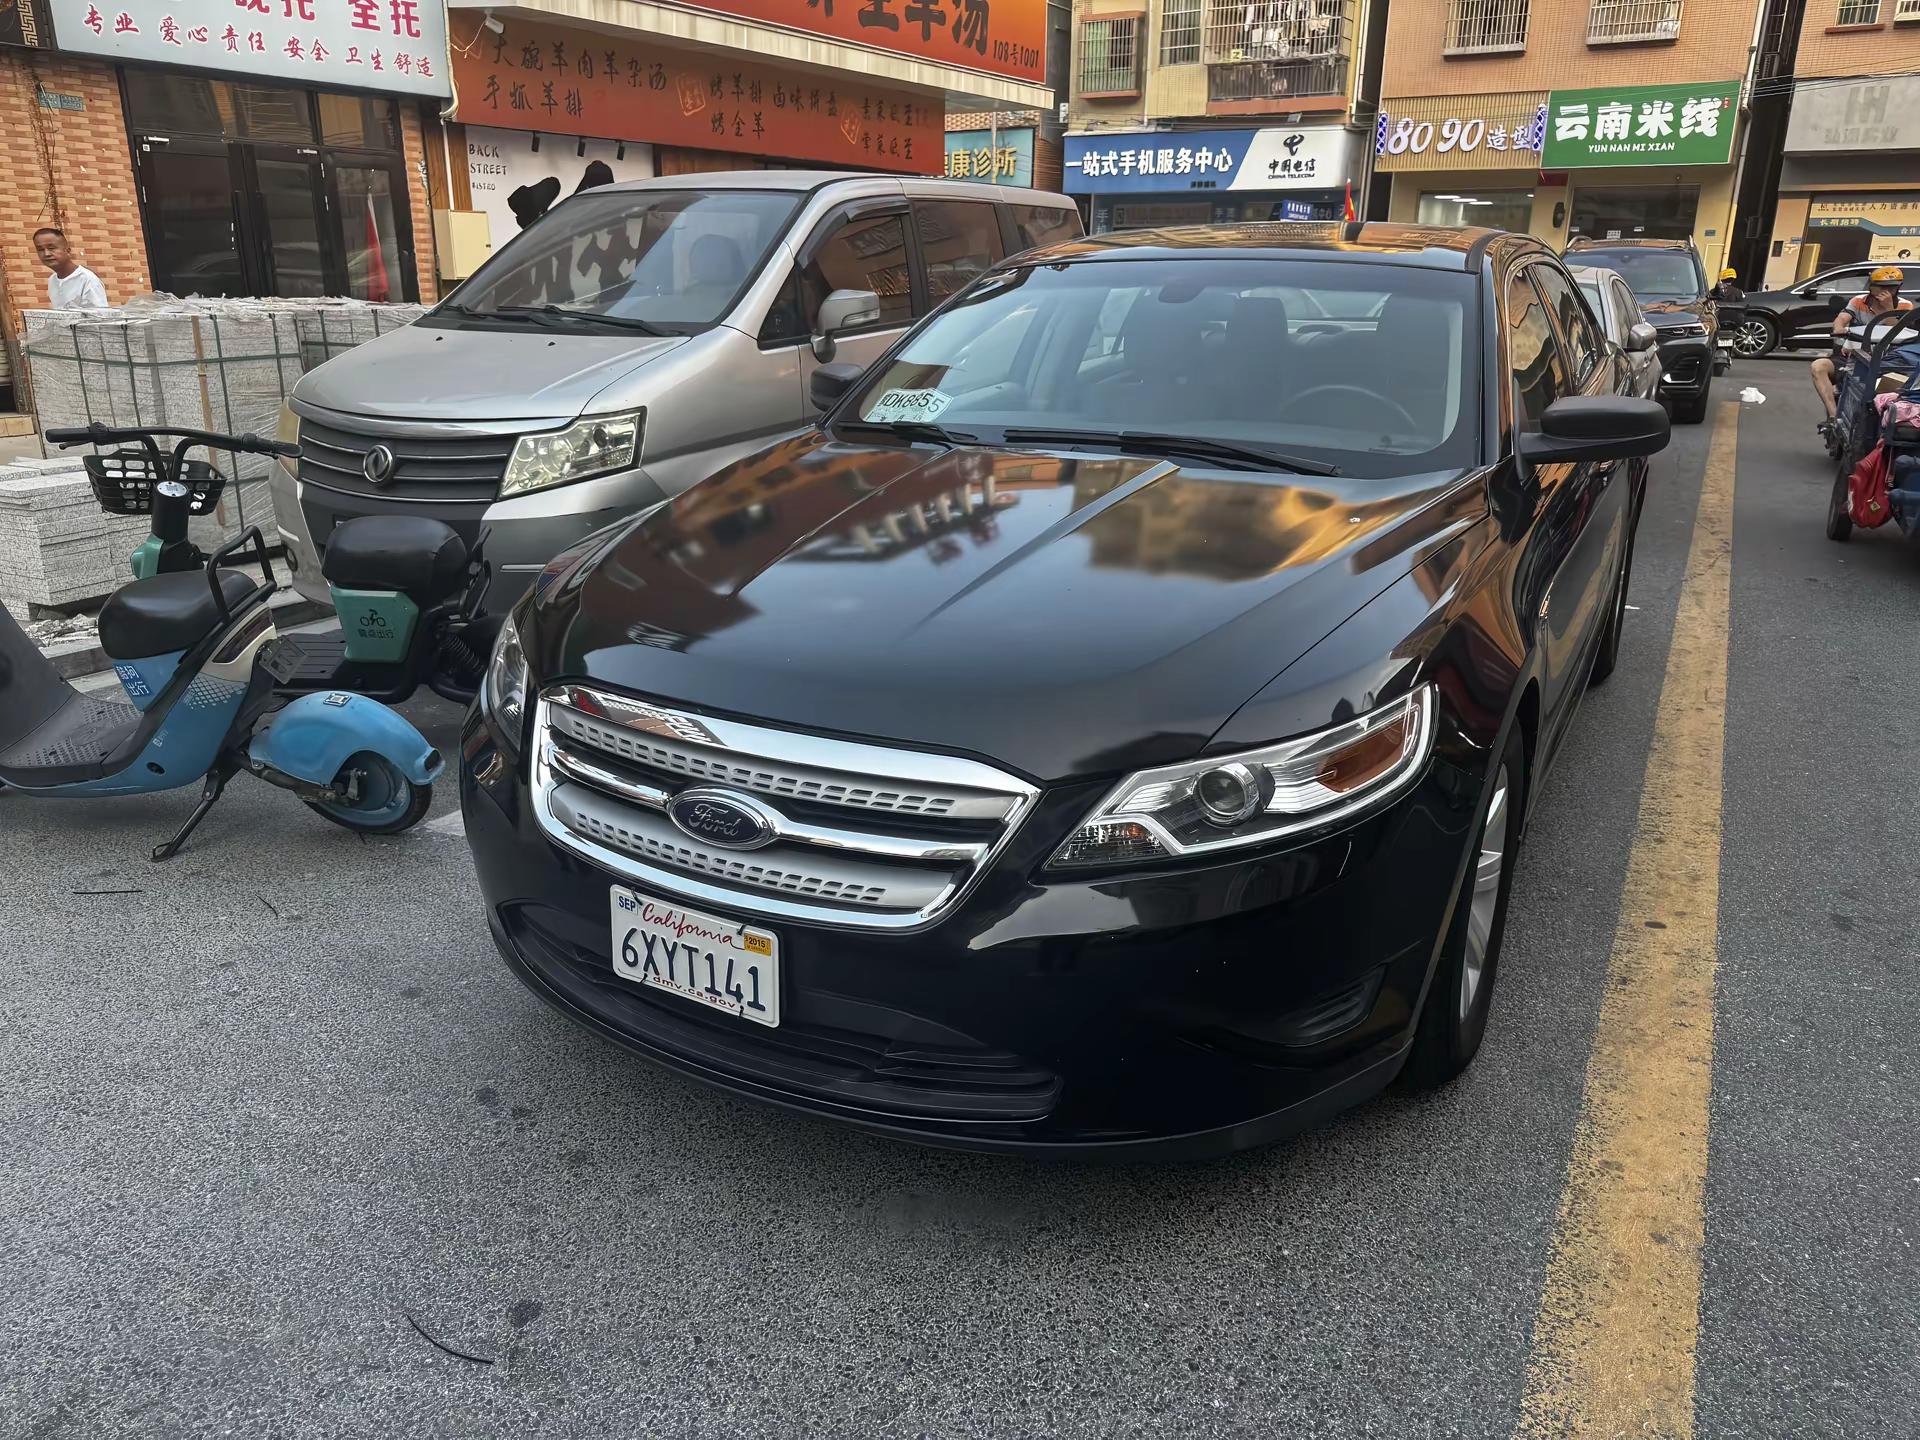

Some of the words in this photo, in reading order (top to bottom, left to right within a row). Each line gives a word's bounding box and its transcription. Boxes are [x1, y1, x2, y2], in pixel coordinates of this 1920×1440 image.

[348, 0, 421, 38] 全托
[83, 4, 140, 35] 专业
[158, 15, 208, 45] 爱心
[220, 23, 266, 53] 责任
[283, 36, 330, 62] 安全
[345, 46, 384, 71] 卫生
[393, 51, 435, 77] 舒适
[993, 39, 1040, 68] 108号1001
[482, 74, 584, 119] 手抓羊排
[711, 110, 765, 139] 烤全羊
[1554, 97, 1723, 142] 云南米线
[469, 143, 500, 158] BACK
[1388, 116, 1435, 155] 80
[1436, 117, 1486, 154] 90
[1486, 123, 1533, 152] 造型
[1588, 144, 1608, 153] YUN
[1609, 143, 1631, 153] NAN
[1631, 143, 1646, 152] MI
[1647, 142, 1676, 152] XIAN
[470, 163, 507, 175] STREET
[944, 147, 1017, 178] 康诊所
[1065, 147, 1233, 177] 一站式手机服务中心
[1268, 158, 1316, 174] 中国电信
[688, 803, 741, 836] Ford
[618, 896, 636, 912] SEP
[642, 903, 744, 950] California
[748, 936, 766, 948] 2015
[622, 927, 766, 1012] 6XYT141
[652, 975, 736, 1010] dmv.ca.gov
